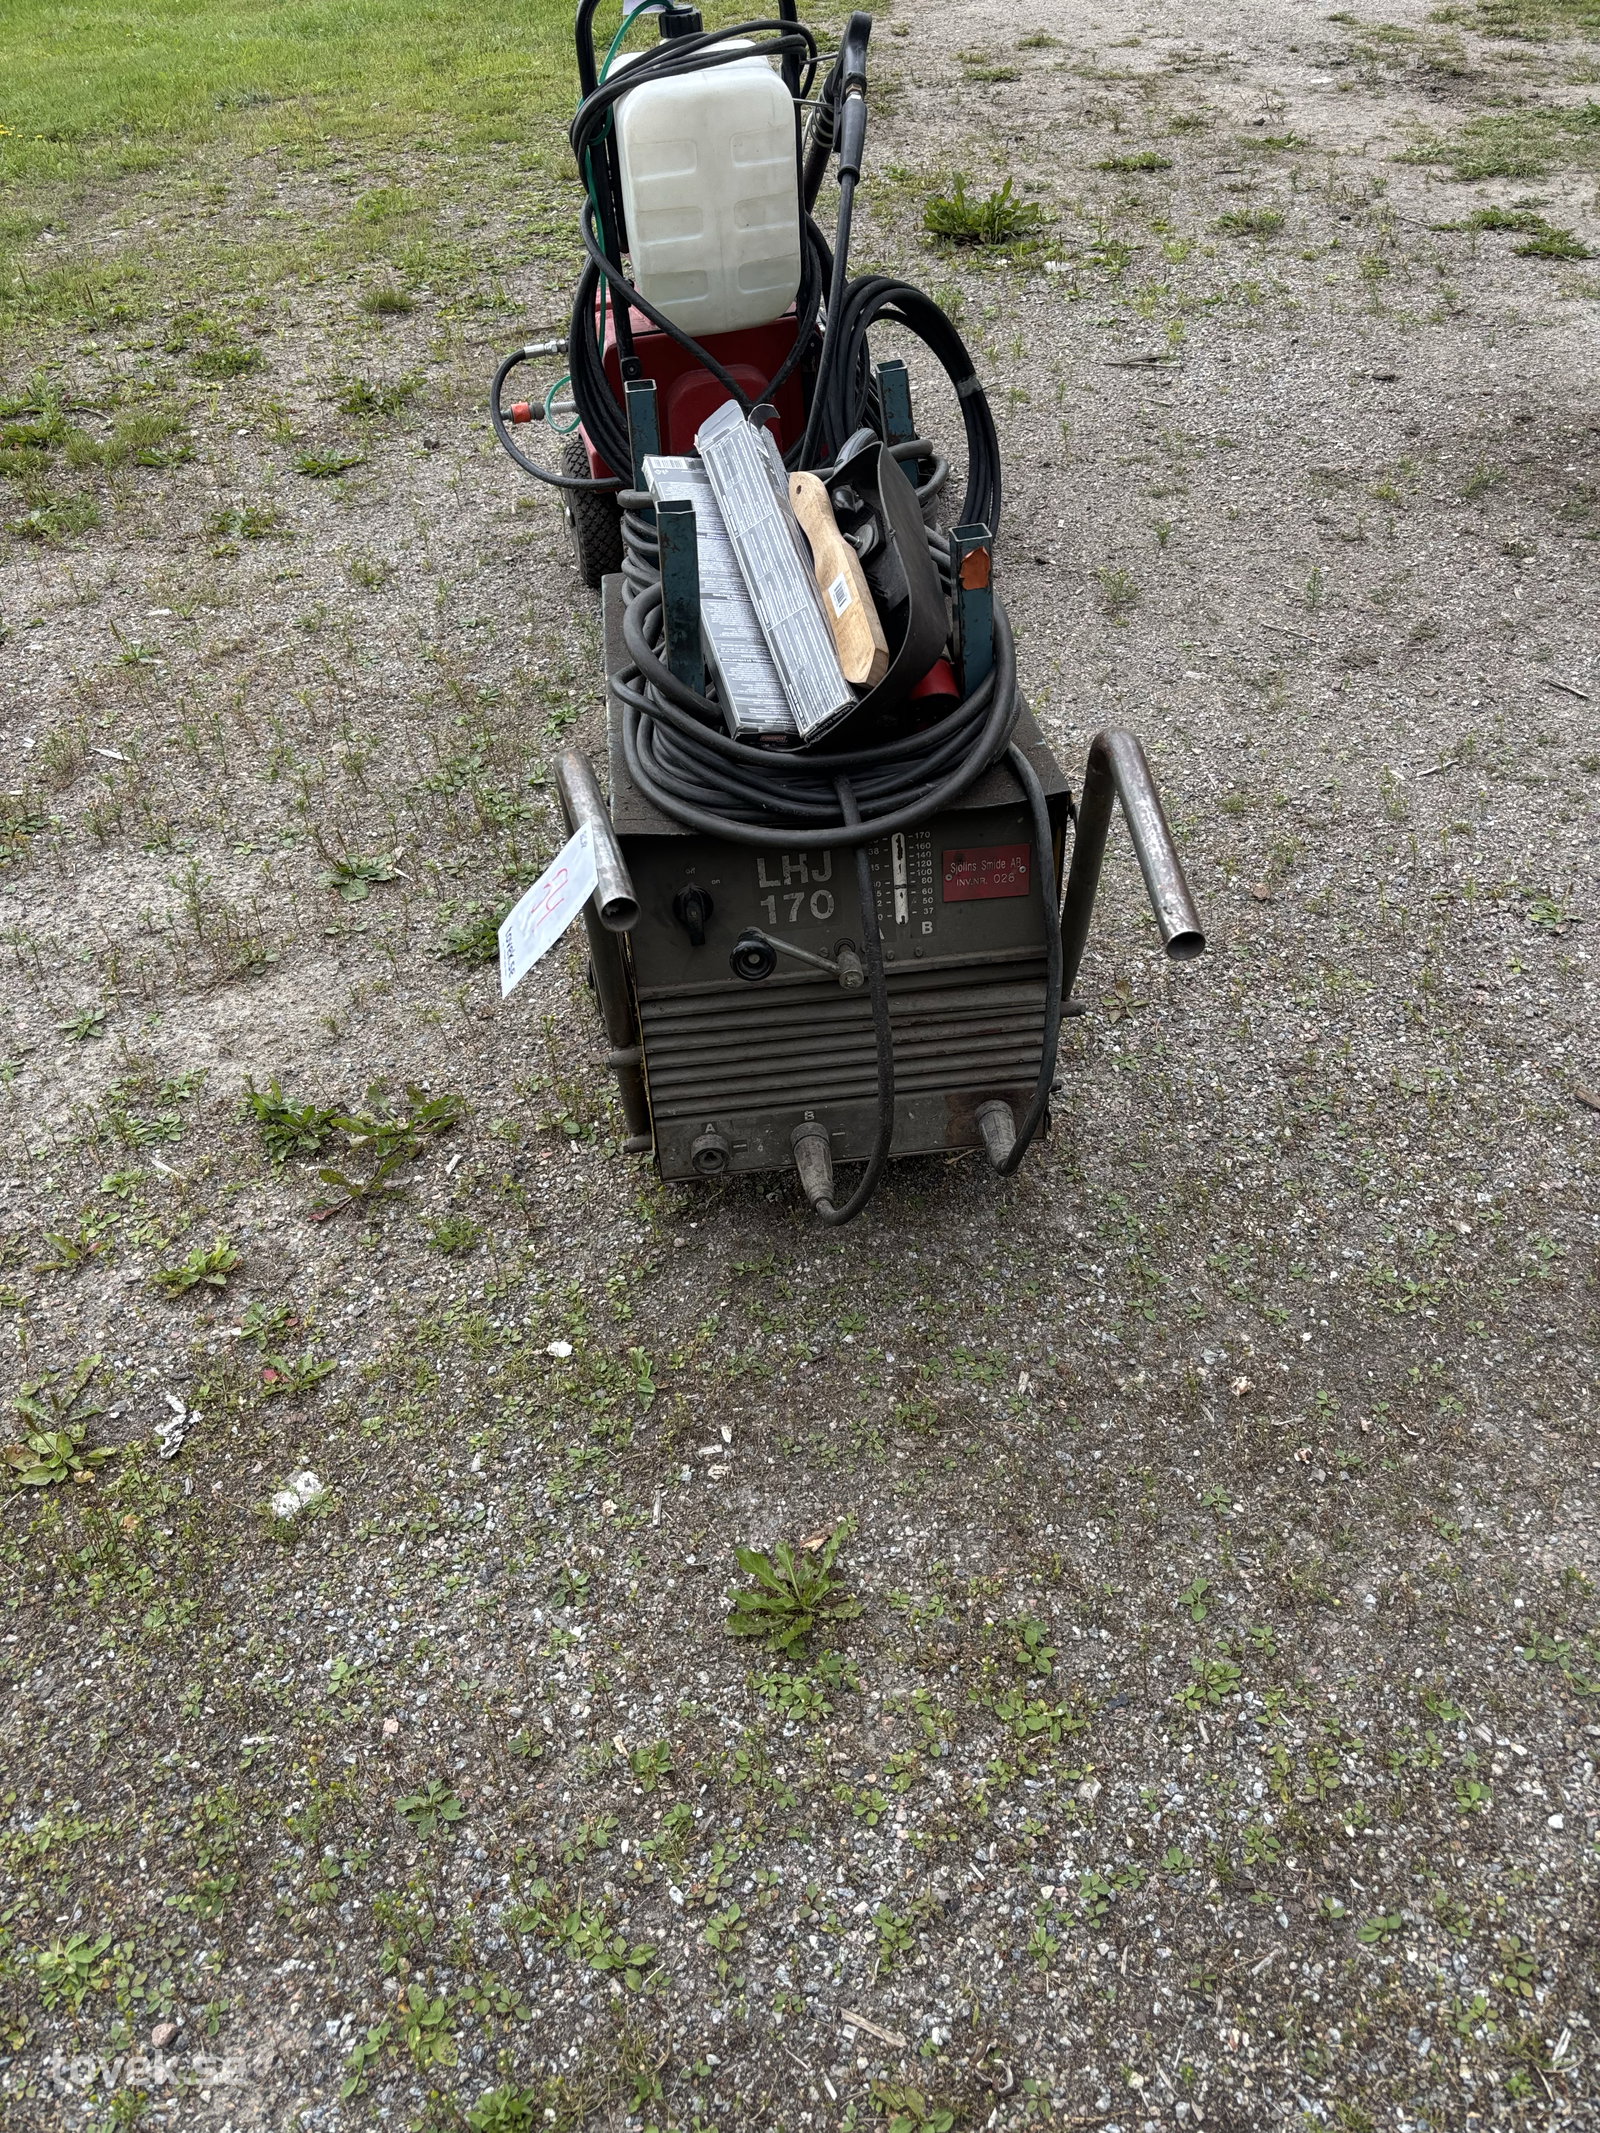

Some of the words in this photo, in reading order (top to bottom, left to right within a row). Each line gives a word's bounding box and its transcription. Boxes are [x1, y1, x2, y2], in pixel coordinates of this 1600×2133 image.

[915, 842, 931, 850] 160
[756, 850, 833, 888] LHJ
[981, 859, 1006, 871] Smide
[917, 868, 933, 876] 100
[921, 876, 933, 884] 80
[922, 887, 933, 895] 60
[760, 889, 835, 925] 170
[923, 907, 934, 915] 37
[921, 921, 933, 935] B
[804, 1110, 815, 1121] B
[704, 1123, 716, 1134] A
